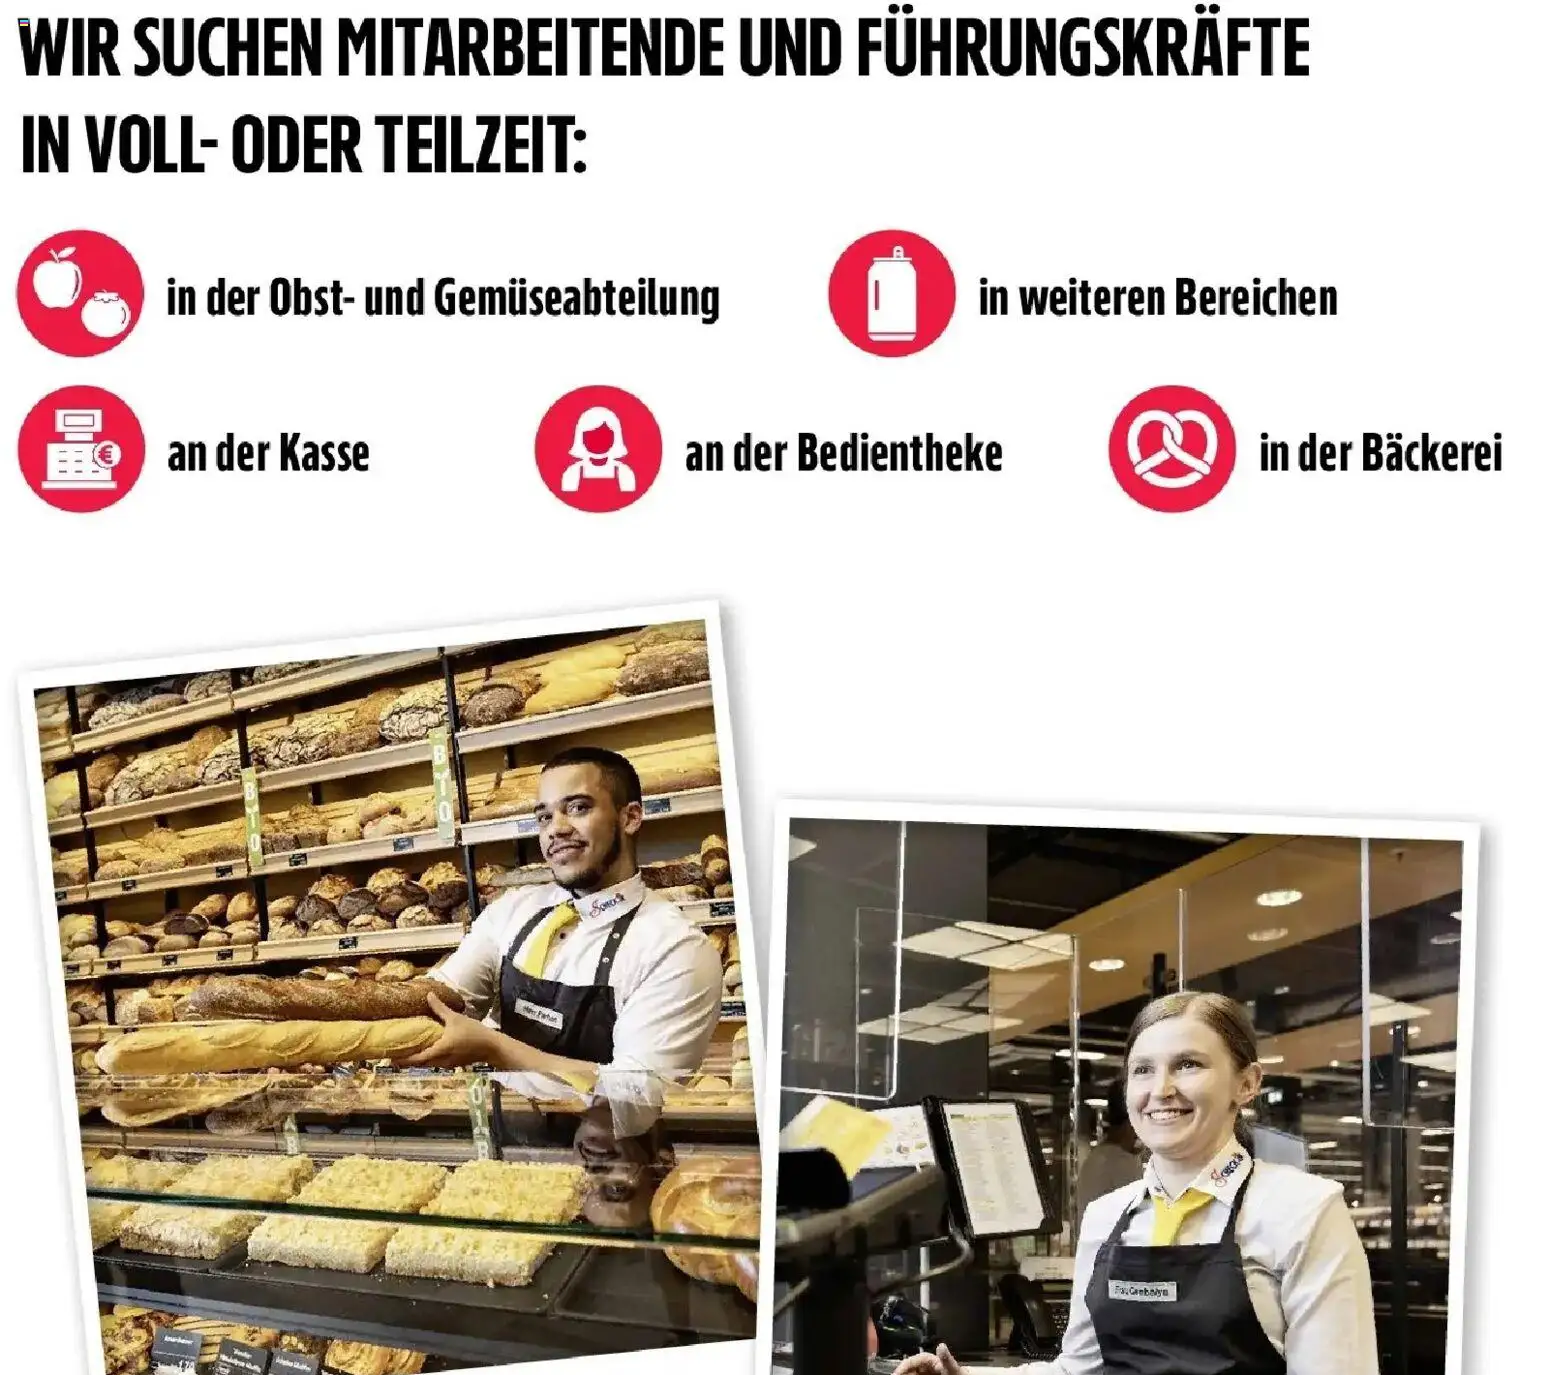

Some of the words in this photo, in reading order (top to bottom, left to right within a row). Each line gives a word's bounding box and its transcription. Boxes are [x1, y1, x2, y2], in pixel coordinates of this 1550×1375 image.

[19, 18, 120, 76] WIR
[134, 17, 321, 76] SUCHEN
[339, 18, 723, 76] MITARBEITENDE
[740, 18, 841, 76] UND
[859, 4, 1309, 76] FÜHRUNGSKRÄFTE
[23, 116, 68, 172] IN
[85, 114, 218, 173] VOLL-
[233, 114, 362, 173] ODER
[375, 116, 586, 173] TEILZEIT:
[168, 278, 195, 315] in
[207, 278, 260, 316] der
[271, 277, 354, 316] Obst-
[366, 278, 423, 316] und
[435, 277, 719, 324] Gemüseabteilung
[980, 278, 1008, 315] in
[1019, 278, 1164, 316] weiteren
[1176, 278, 1337, 316] Bereichen
[168, 441, 206, 471] an
[216, 433, 270, 471] der
[281, 433, 369, 471] Kasse
[686, 441, 723, 471] an
[734, 433, 787, 471] der
[799, 433, 1002, 471] Bedientheke
[1261, 433, 1288, 471] in
[1299, 433, 1352, 471] der
[1363, 433, 1501, 471] Bäckerei
